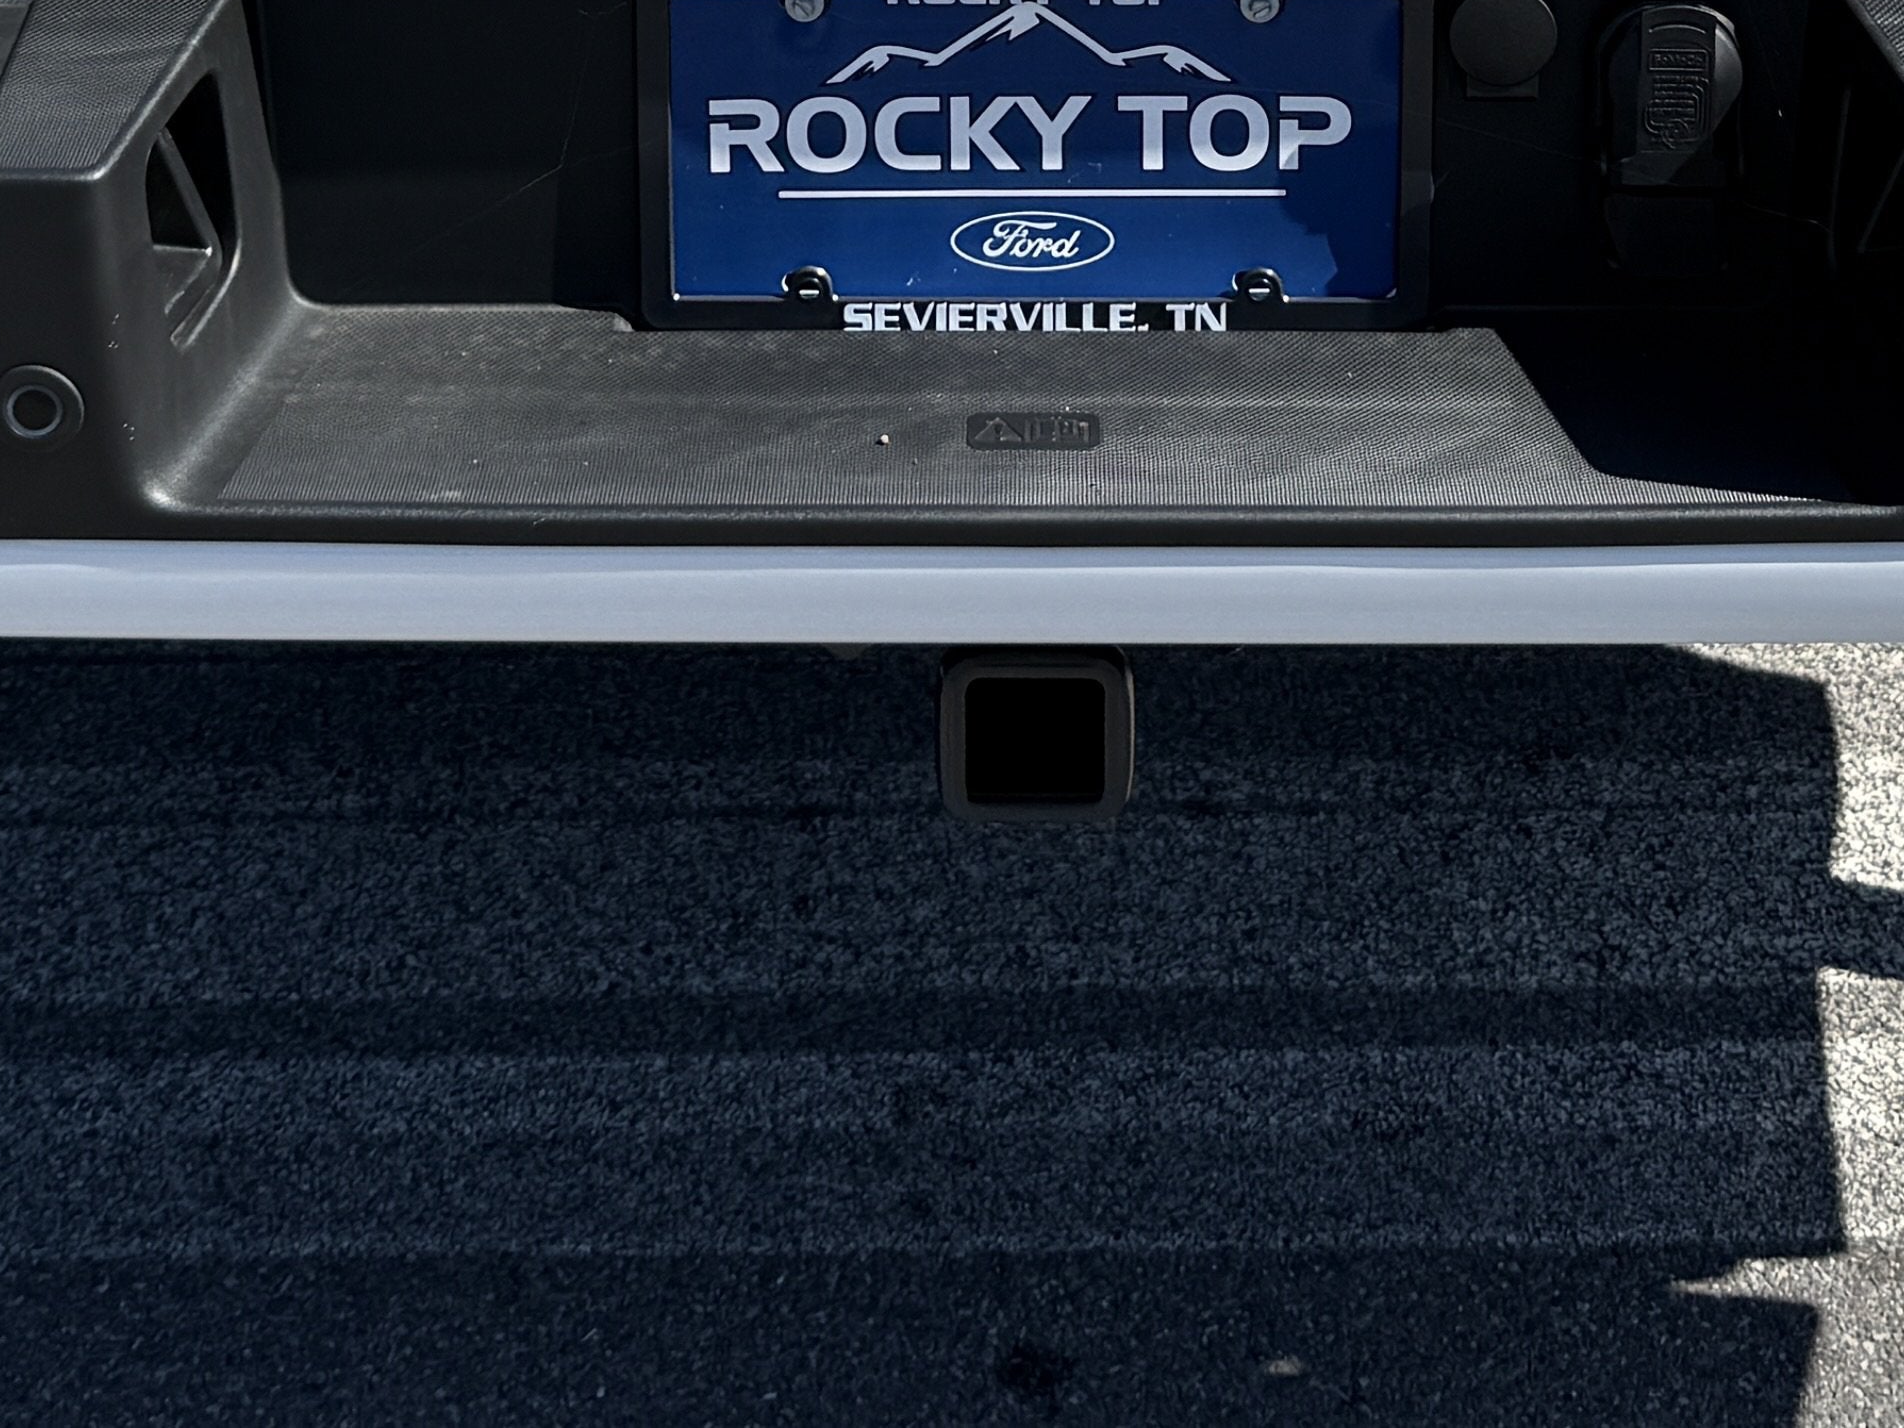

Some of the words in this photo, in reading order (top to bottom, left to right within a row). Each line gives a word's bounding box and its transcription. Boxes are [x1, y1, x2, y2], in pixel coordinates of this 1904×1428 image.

[708, 95, 1092, 174] ROCKY
[1117, 94, 1353, 172] TOP
[981, 219, 1082, 259] Ford
[1166, 302, 1227, 332] TN
